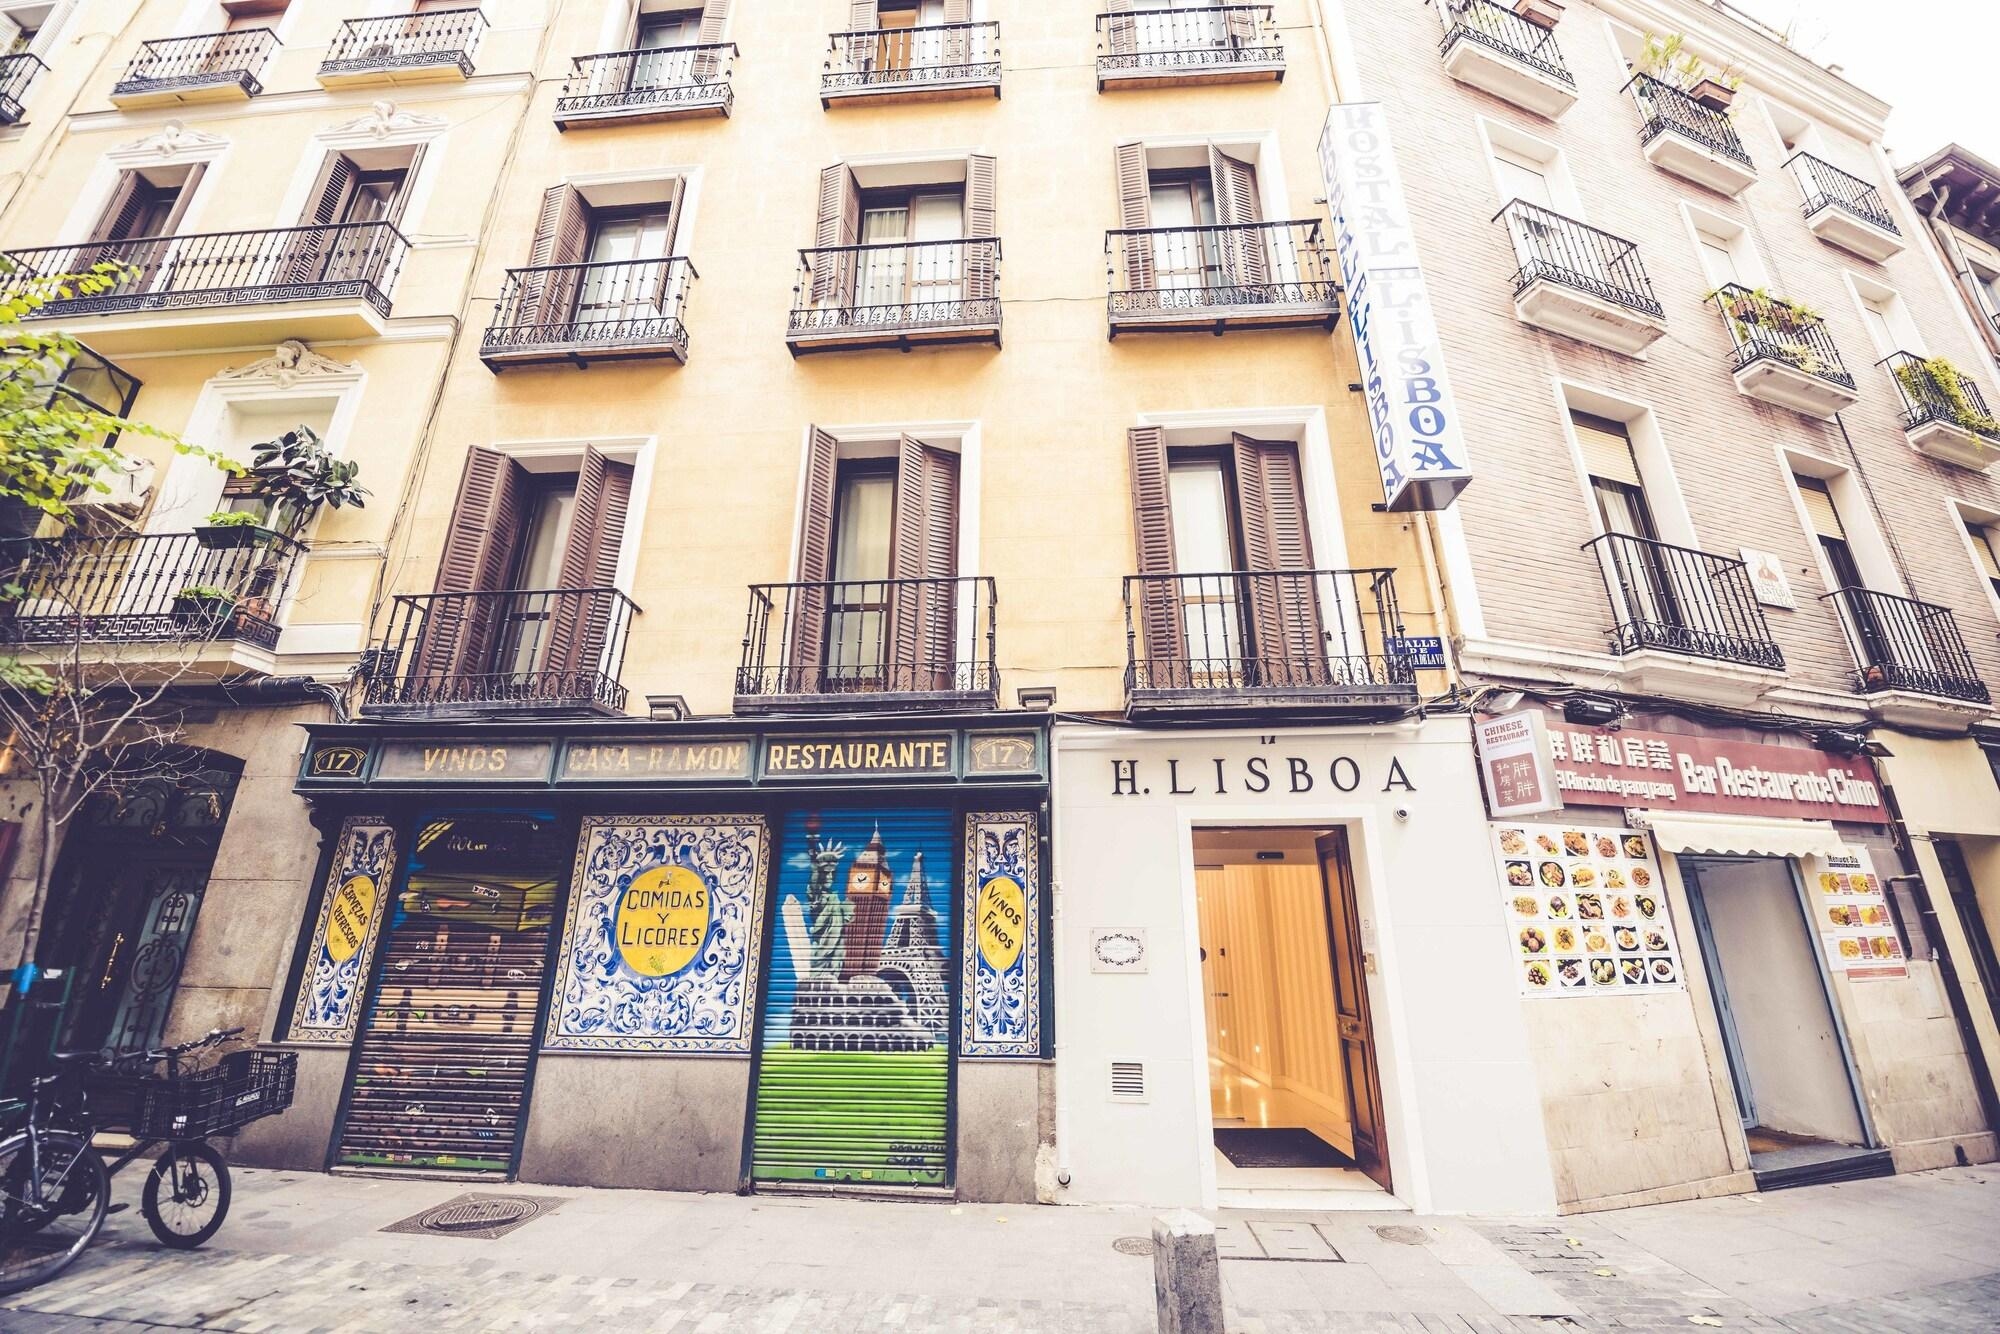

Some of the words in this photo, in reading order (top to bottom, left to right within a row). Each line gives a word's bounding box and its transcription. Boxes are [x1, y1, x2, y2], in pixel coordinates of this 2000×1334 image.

[1342, 107, 1410, 257] HOSTAL
[1377, 282, 1463, 473] LISBOA
[1352, 302, 1405, 498] LISBOA
[1484, 720, 1524, 737] CHINESE
[1486, 729, 1530, 745] RESTAURANT
[325, 753, 352, 770] 17
[423, 748, 508, 772] VINOS
[769, 742, 947, 770] RESTAURANTE
[991, 745, 1015, 764] 17
[1111, 759, 1150, 795] H.
[1167, 755, 1417, 795] LISBOA
[1606, 774, 1622, 794] de
[1620, 780, 1650, 799] pang
[1648, 782, 1677, 801] pang
[1676, 753, 1718, 795] Bar
[1714, 756, 1834, 803] Restaurante
[1827, 768, 1880, 807] Chino
[341, 883, 368, 926] CERVEZAS
[626, 889, 705, 910] COMIDAS
[988, 885, 1022, 926] VINOS
[333, 905, 358, 949] REFRESCOS
[657, 913, 670, 924] Y
[982, 910, 1014, 949] FINOS
[622, 921, 701, 946] LICORES
